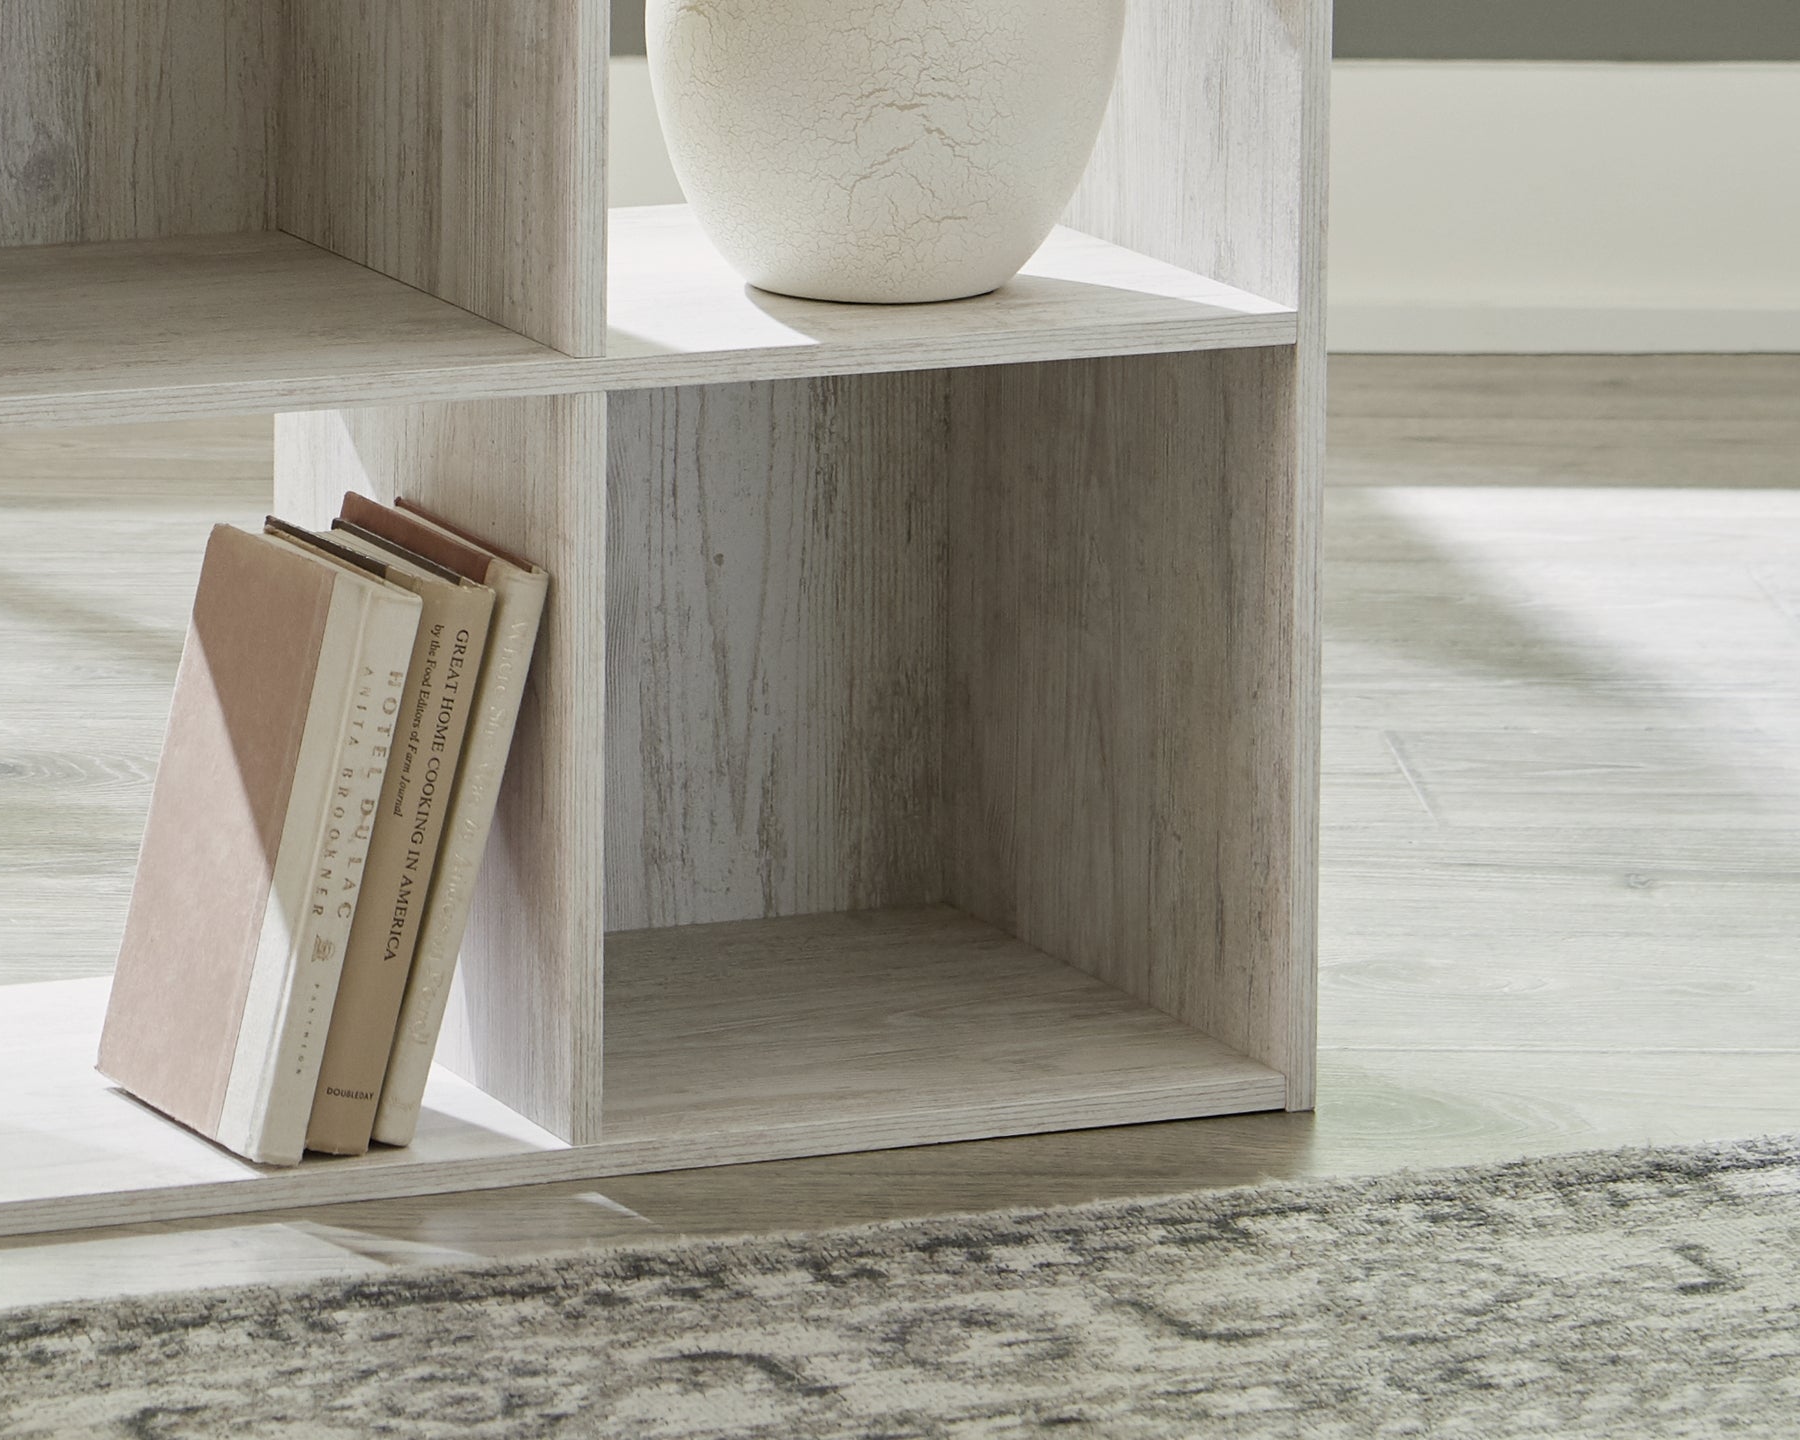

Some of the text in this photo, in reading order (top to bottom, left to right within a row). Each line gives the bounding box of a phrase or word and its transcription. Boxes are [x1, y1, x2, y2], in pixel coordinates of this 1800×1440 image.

[312, 666, 375, 916] ANITA BROOKNER
[366, 669, 404, 779] HOTEL
[384, 628, 470, 962] GREAT HOME COOKING IN AMERICA
[393, 624, 445, 818] by the Food Editors of Farm Journal
[336, 856, 363, 919] LAC
[326, 1086, 375, 1101] DOUBLEDAY
